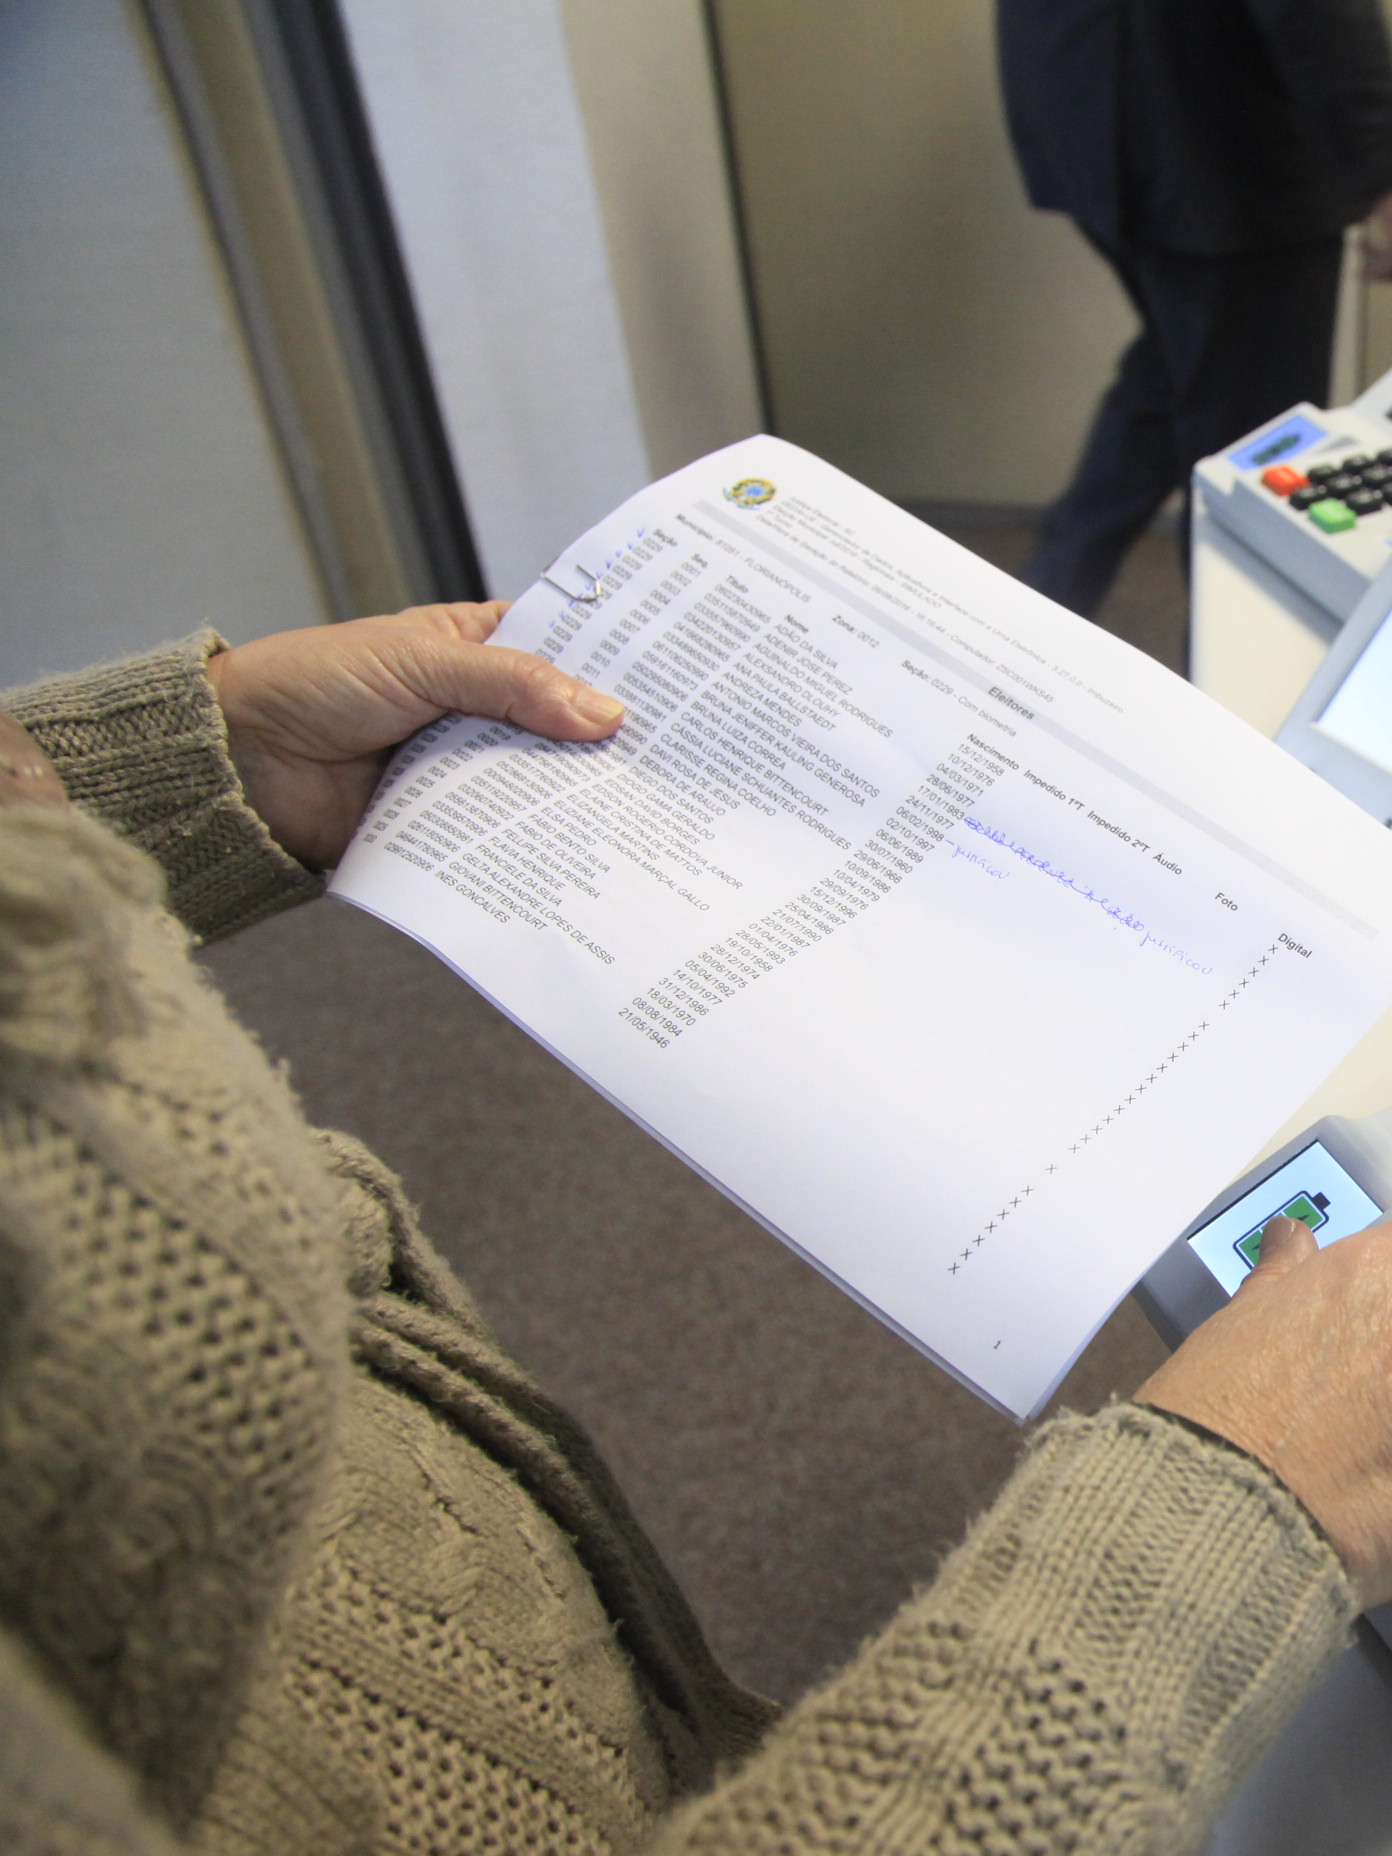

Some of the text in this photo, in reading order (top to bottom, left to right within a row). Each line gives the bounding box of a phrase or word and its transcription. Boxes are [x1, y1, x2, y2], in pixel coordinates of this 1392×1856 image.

[721, 671, 954, 830] ANDREZA MENDES 24/11/1977
[831, 615, 859, 634] Zona:
[855, 631, 880, 648] 0012
[899, 660, 932, 683] Seção:
[929, 678, 954, 695] 0229
[956, 696, 980, 712] Com
[976, 709, 1018, 737] biometria
[986, 687, 1036, 720] Eleitores
[648, 744, 880, 903] DAVI ROSA DE JESUS 10/04/1979
[659, 734, 891, 894] CLARISSE REGINA COELHO 10/09/1986
[679, 712, 914, 874] CARLOS HENRIQUE BITTENCOURT 30/07/1960
[689, 701, 924, 863] BRUNA LUIZA CORREA 06/06/1989
[699, 690, 934, 852] BRUNA JENIFFER KAULING GENEROSA 02/10/1997
[710, 680, 945, 842] ANTONIO MARCOS VIEIRA DOS SANTOS 06/02/1998
[782, 614, 810, 633] Nome
[965, 733, 1020, 770] Nascimento
[1020, 769, 1067, 802] Impedido
[1084, 810, 1131, 843] Impedido
[1151, 851, 1186, 875] Áudio
[1213, 892, 1240, 911] Foto
[1274, 933, 1312, 960] Digital
[915, 785, 966, 820] 17/01/1983
[925, 773, 975, 808] 28/06/1977
[935, 762, 985, 797] 04/03/1971
[945, 752, 995, 786] 10/12/1976
[956, 743, 1005, 776] 15/12/1958
[460, 851, 697, 1026] GELTA ALEXANDRE LOPES DE ASSIS 18/03/1970
[474, 843, 710, 1016] FRANCIELE DA SILVA 31/12/1986
[487, 835, 723, 1007] FLAVIA HENRIQUE 14/10/1977
[501, 827, 735, 998] FELLIPE SILVA PEREIRA 05/04/1992
[514, 819, 748, 989] FABIO DE OLIVEIRA 30/06/1975
[539, 805, 773, 973] ELSA PEDRO 19/10/1958
[553, 799, 595, 829] ELIZIANE
[590, 826, 643, 864] ELEONORA
[675, 887, 710, 912] GALLO
[735, 928, 786, 965] 28/05/1993
[553, 831, 587, 856] BENTO
[583, 852, 611, 874] SILVA
[709, 943, 761, 981] 28/12/1974
[565, 792, 798, 958] ELIZANGELA MARTINS 01/04/1976
[578, 787, 810, 951] ELAINE CRISTINA DE MATTOS 22/01/1987
[590, 782, 822, 943] EDSON ROGERIO CORDOVA JUNIOR 21/07/1990
[784, 900, 833, 936] 25/04/1986
[796, 892, 845, 928] 30/09/1987
[808, 884, 857, 920] 15/12/1996
[819, 876, 869, 912] 29/09/1976
[853, 849, 902, 884] 29/06/1966
[434, 869, 671, 1048] INES GONCALVES 21/05/1946
[448, 860, 684, 1037] GIOVANI BITTENCOURT 08/08/1984
